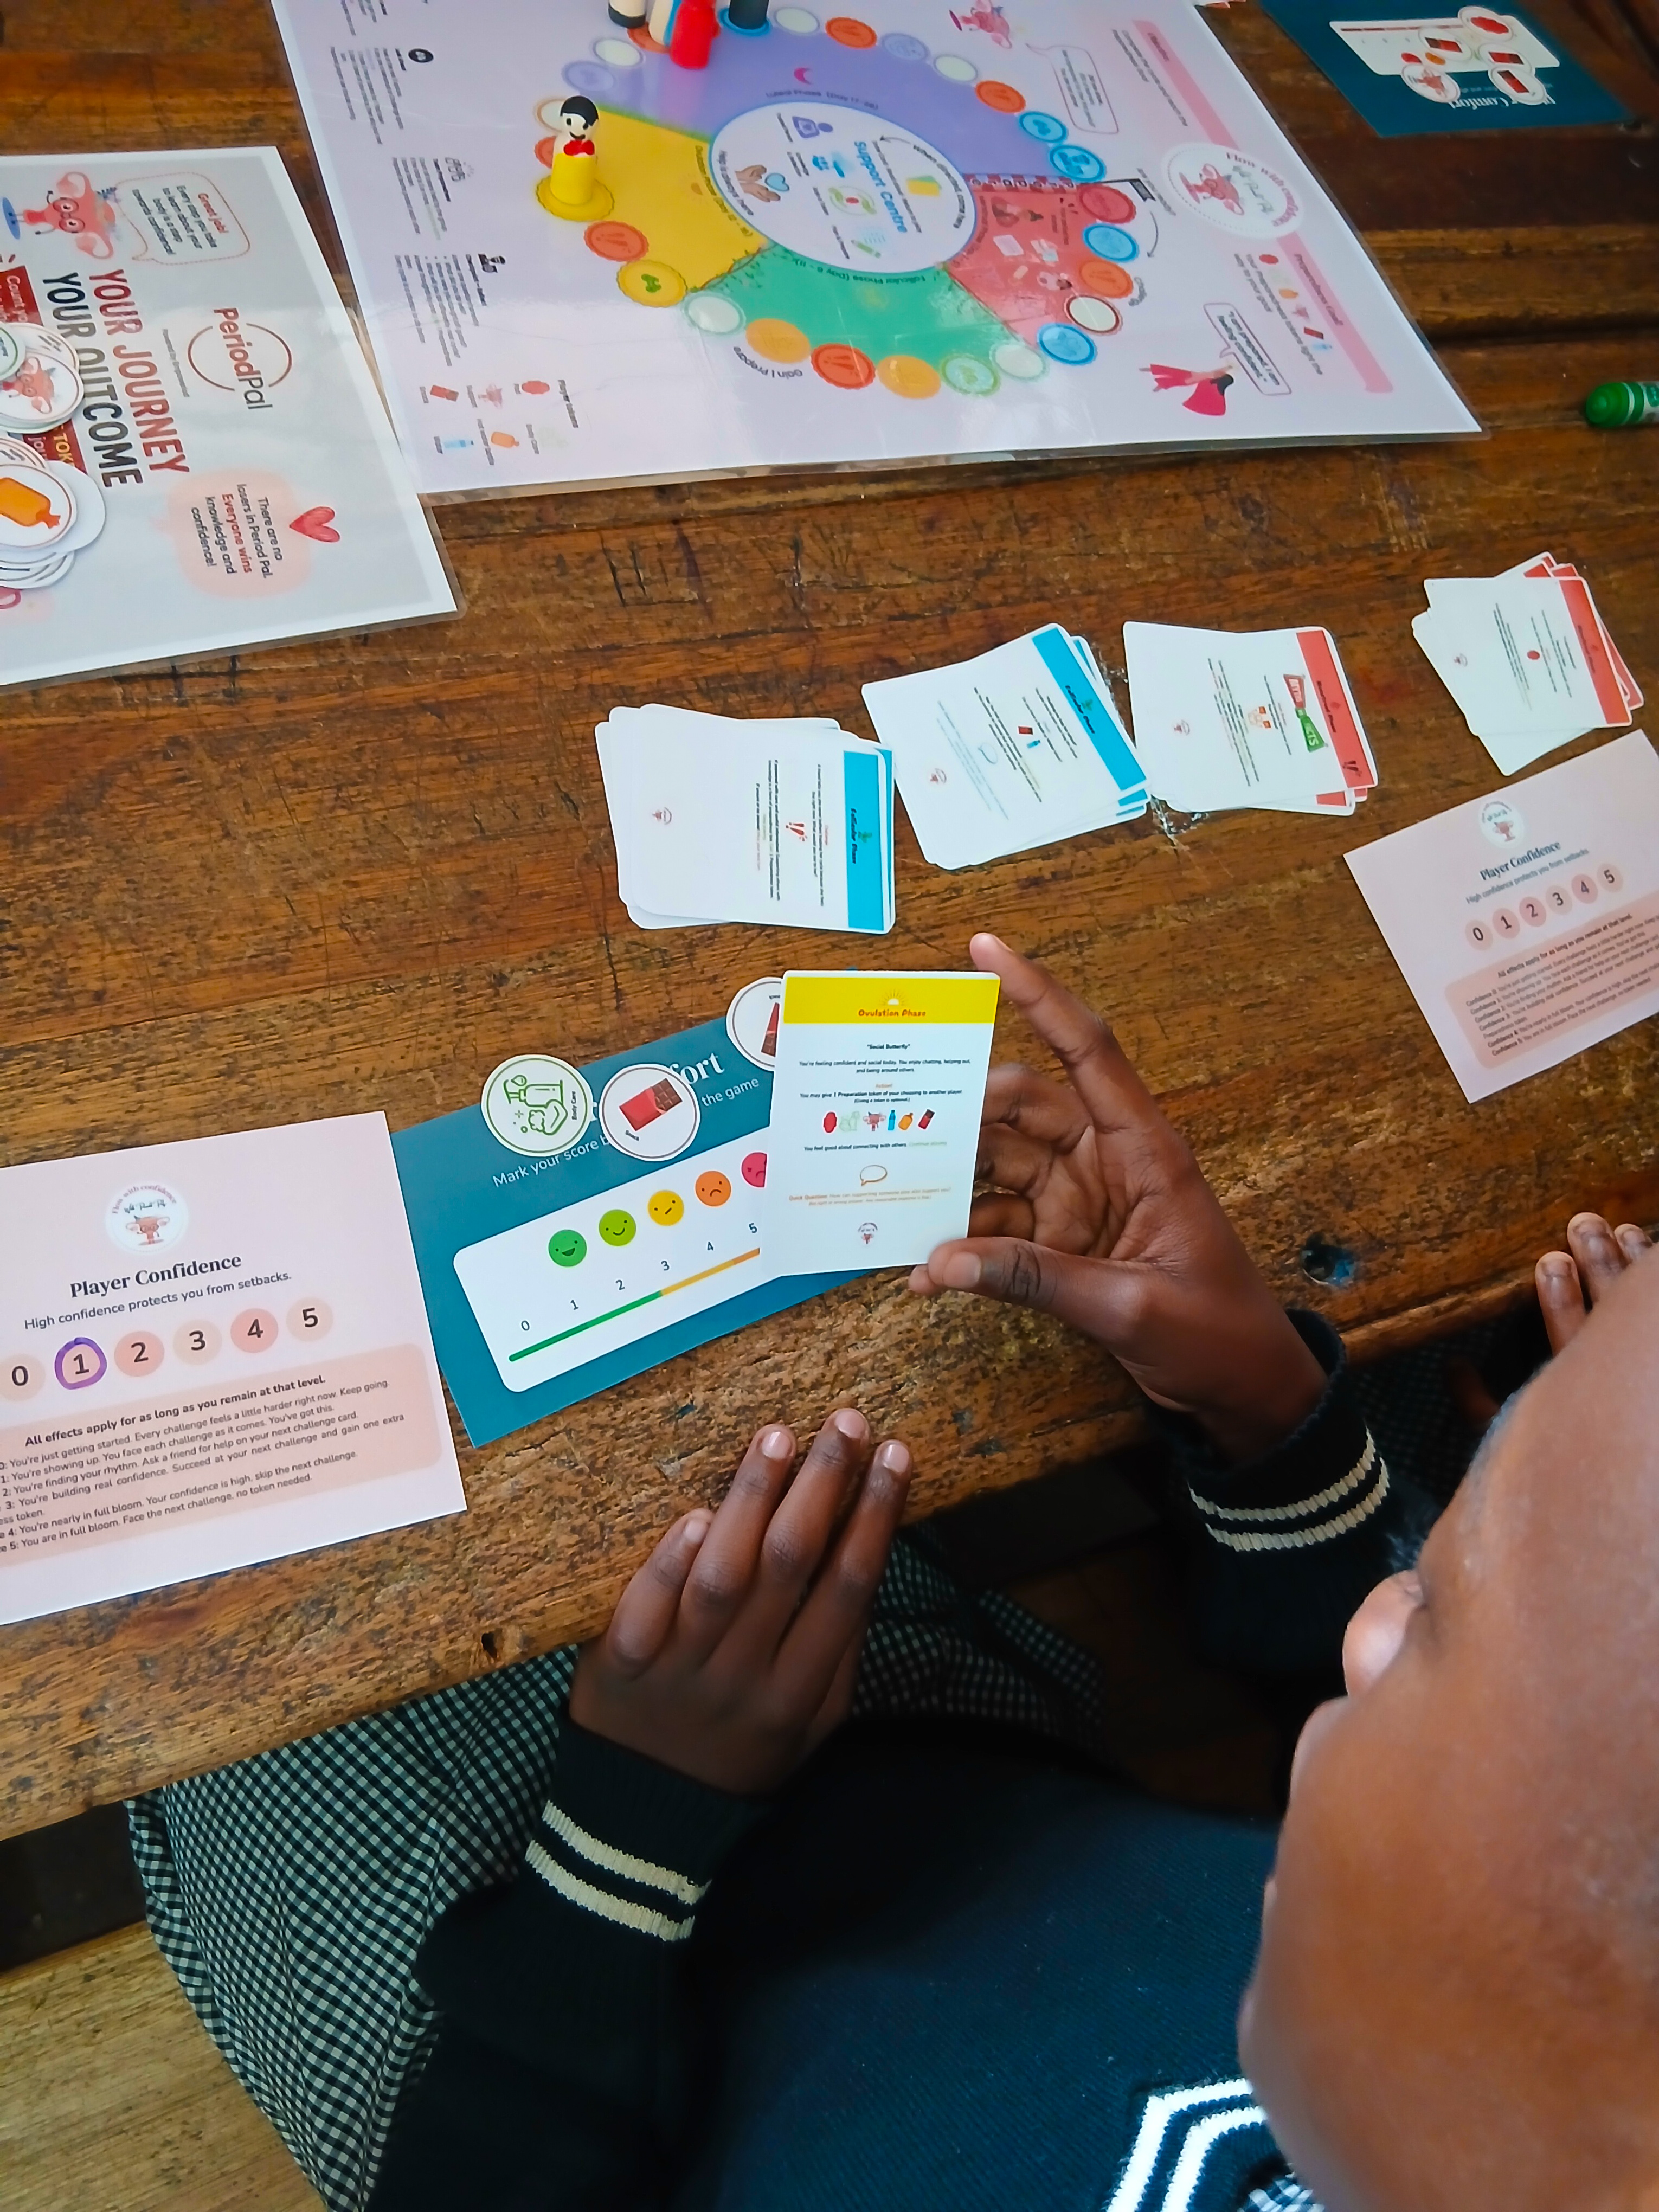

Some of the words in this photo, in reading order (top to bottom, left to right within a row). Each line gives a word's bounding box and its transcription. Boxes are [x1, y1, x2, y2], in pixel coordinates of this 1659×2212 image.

[853, 140, 886, 187] Support
[879, 190, 908, 233] Centre
[89, 269, 143, 335] YOUR
[42, 272, 97, 338] YOUR
[77, 348, 144, 487] OUTCOME
[112, 344, 190, 473] JOURNEY
[236, 484, 252, 513] losers
[245, 513, 256, 524] in
[257, 496, 273, 526] There
[266, 527, 278, 545] are
[272, 546, 283, 561] no
[190, 506, 217, 566] confidence!
[204, 496, 228, 552] knowledge
[221, 552, 237, 574] and
[221, 493, 244, 545] Everyone
[237, 546, 252, 573] wins
[248, 525, 268, 558] Period
[259, 559, 273, 578] Pal.
[1480, 864, 1509, 882] Player
[1509, 841, 1561, 868] Confidence
[1472, 927, 1484, 941] 0
[1500, 915, 1512, 929] 1
[1526, 903, 1539, 918] 2
[1552, 892, 1564, 906] 3
[1580, 880, 1590, 893] 4
[1604, 869, 1615, 884] 5
[858, 1008, 899, 1017] Ovulation
[901, 1008, 926, 1017] Phase
[701, 1093, 724, 1107] the
[724, 1078, 760, 1100] game
[492, 1165, 529, 1187] Mark
[530, 1154, 560, 1175] your
[563, 1140, 599, 1160] score
[24, 1315, 55, 1330] High
[57, 1303, 125, 1323] confidence
[128, 1293, 178, 1313] protects
[181, 1288, 203, 1302] you
[205, 1283, 235, 1295] from
[237, 1271, 292, 1289] setbacks.
[69, 1276, 131, 1298] Player
[134, 1255, 242, 1285] Confidence
[521, 1320, 530, 1331] 0
[570, 1300, 579, 1310] 1
[615, 1279, 625, 1291] 2
[661, 1260, 670, 1271] 3
[706, 1241, 715, 1252] 4
[749, 1223, 757, 1234] 5
[11, 1365, 29, 1387] 0
[73, 1354, 90, 1375] 1
[131, 1342, 149, 1364] 2
[189, 1330, 207, 1351] 3
[247, 1319, 264, 1340] 4
[302, 1308, 319, 1328] 5
[9, 1456, 39, 1468] You're
[41, 1451, 60, 1463] just
[60, 1444, 95, 1459] getting
[134, 1430, 161, 1441] Every
[163, 1419, 208, 1435] challenge
[209, 1413, 232, 1425] feels
[240, 1406, 262, 1418] little
[263, 1400, 292, 1413] harder
[294, 1394, 316, 1407] right
[339, 1385, 362, 1396] Keep
[24, 1434, 43, 1447] All
[44, 1427, 83, 1442] effects
[86, 1419, 118, 1435] apply
[120, 1416, 136, 1426] for
[139, 1413, 152, 1422] as
[153, 1407, 179, 1419] long
[182, 1404, 195, 1413] as
[196, 1399, 217, 1412] you
[220, 1390, 257, 1405] remain
[259, 1386, 271, 1396] at
[272, 1381, 296, 1393] that
[297, 1374, 326, 1388] level.
[0, 1474, 10, 1484] 1:
[10, 1469, 41, 1481] You're
[43, 1459, 84, 1475] showing
[101, 1451, 120, 1461] You
[121, 1447, 142, 1457] face
[143, 1440, 166, 1452] each
[168, 1431, 213, 1447] challenge
[215, 1429, 226, 1437] as
[227, 1425, 234, 1433] it
[268, 1412, 298, 1424] You've
[299, 1407, 315, 1419] got
[2, 1487, 11, 1497] 2:
[12, 1482, 43, 1494] You're
[44, 1474, 79, 1488] finding
[79, 1469, 101, 1482] your
[142, 1455, 160, 1467] Ask
[169, 1446, 197, 1459] friend
[198, 1444, 211, 1454] for
[213, 1439, 234, 1450] help
[235, 1436, 248, 1445] on
[249, 1431, 269, 1444] your
[271, 1426, 292, 1437] next
[293, 1417, 336, 1432] challenge
[9, 1540, 19, 1550] 5:
[20, 1538, 39, 1547] You
[41, 1533, 57, 1543] are
[58, 1531, 68, 1539] in
[69, 1525, 86, 1536] full
[122, 1513, 145, 1524] Face
[146, 1509, 162, 1519] the
[164, 1503, 185, 1515] next
[235, 1489, 248, 1498] no
[249, 1483, 275, 1495] token
